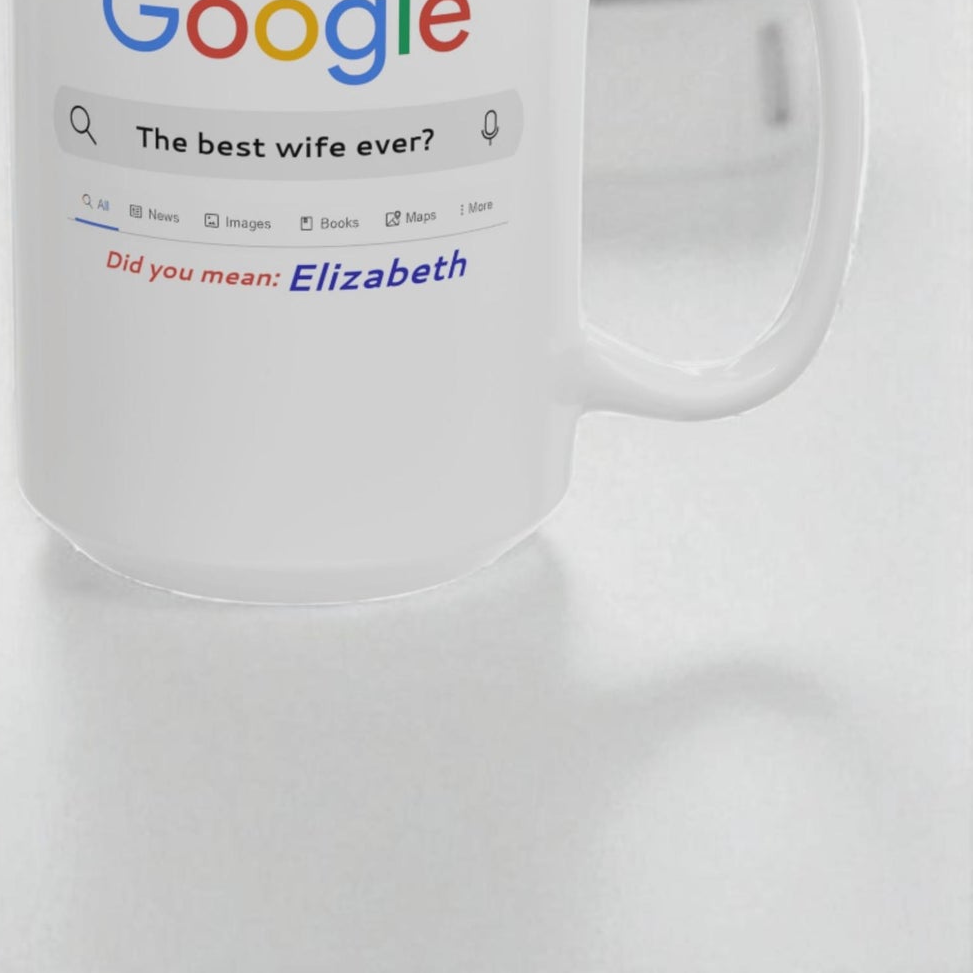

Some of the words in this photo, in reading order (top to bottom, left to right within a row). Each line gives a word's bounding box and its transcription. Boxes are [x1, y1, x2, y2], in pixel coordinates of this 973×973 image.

[136, 125, 188, 153] The
[198, 131, 266, 158] best
[275, 135, 346, 159] wife
[356, 128, 434, 156] ever?
[97, 199, 109, 211] All
[148, 208, 180, 224] News
[226, 216, 272, 232] Images
[320, 217, 359, 229] Books
[406, 211, 436, 226] Maps
[468, 200, 493, 214] More
[106, 250, 144, 274] Did
[149, 262, 194, 283] you
[200, 269, 281, 287] mean:
[289, 249, 467, 292] Elizabeth
